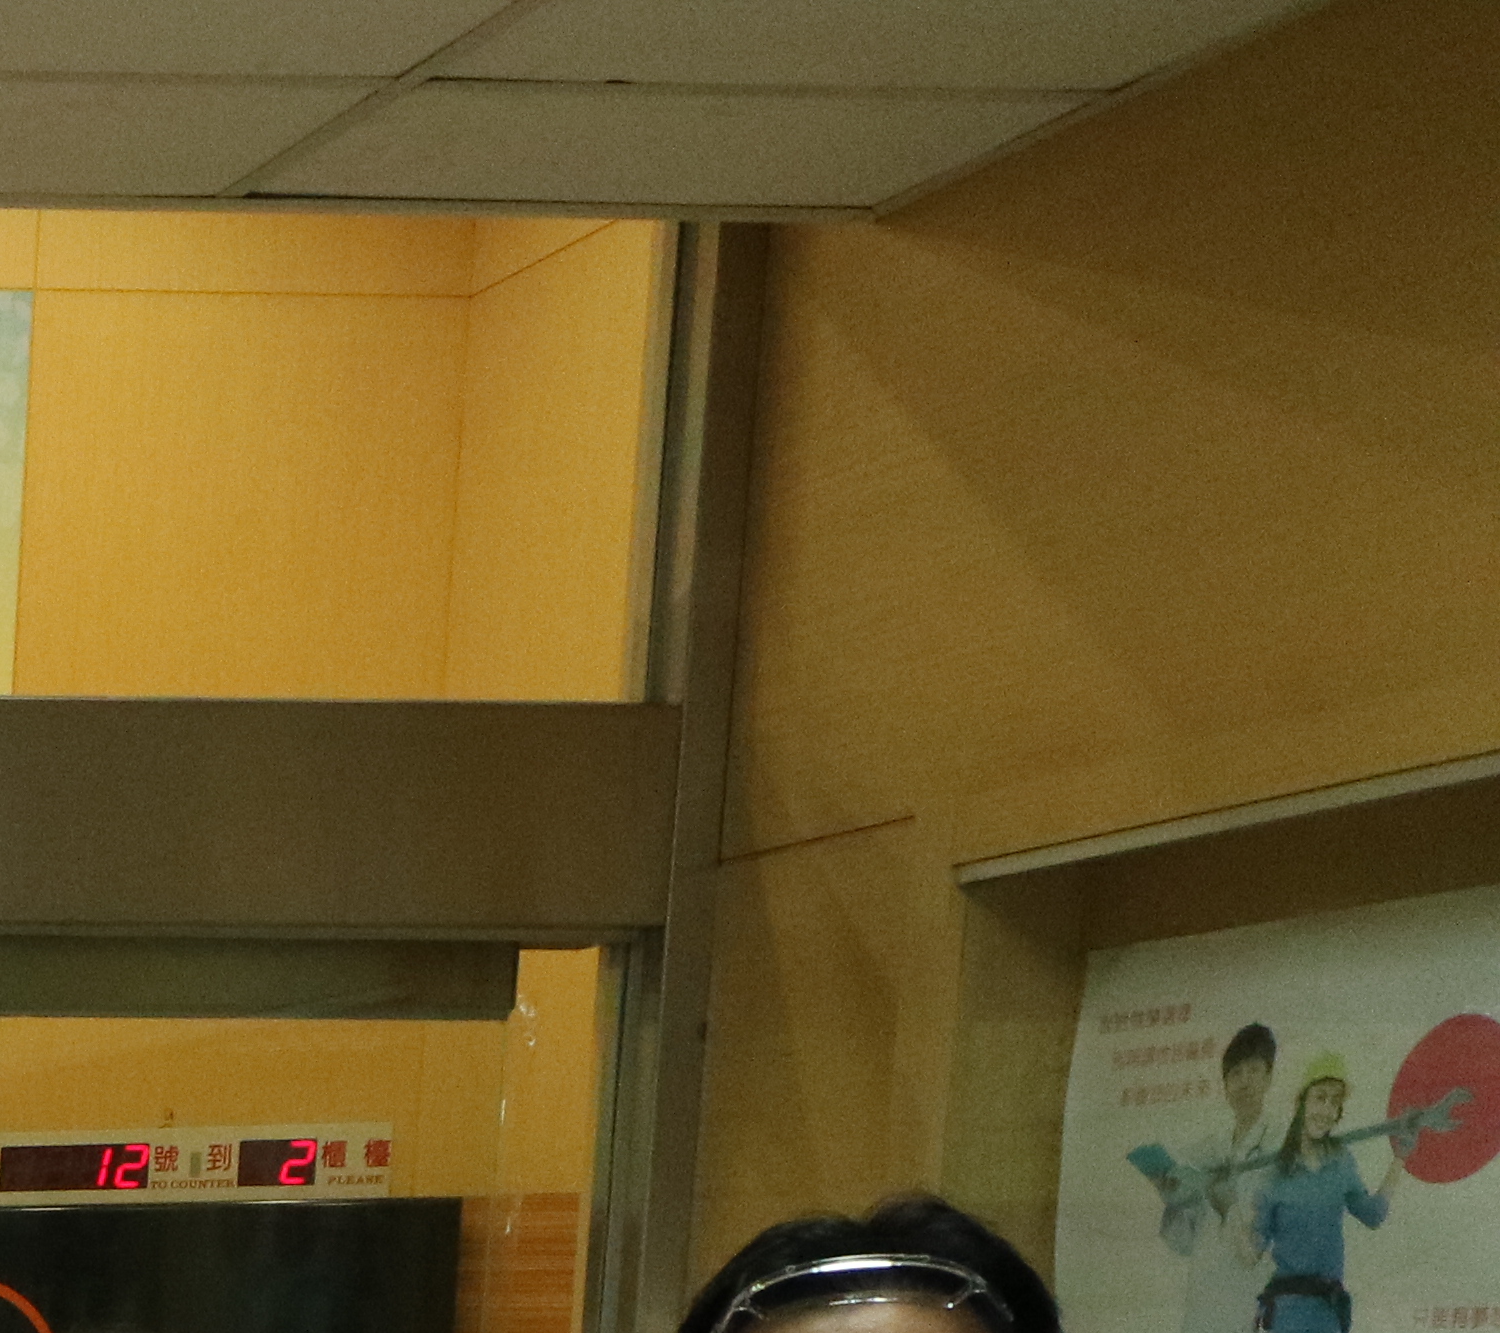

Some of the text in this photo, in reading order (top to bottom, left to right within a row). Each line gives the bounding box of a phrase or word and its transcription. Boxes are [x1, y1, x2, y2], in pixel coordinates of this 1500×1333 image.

[96, 1143, 151, 1188] 12
[206, 1144, 233, 1170] 到
[277, 1139, 317, 1185] 2
